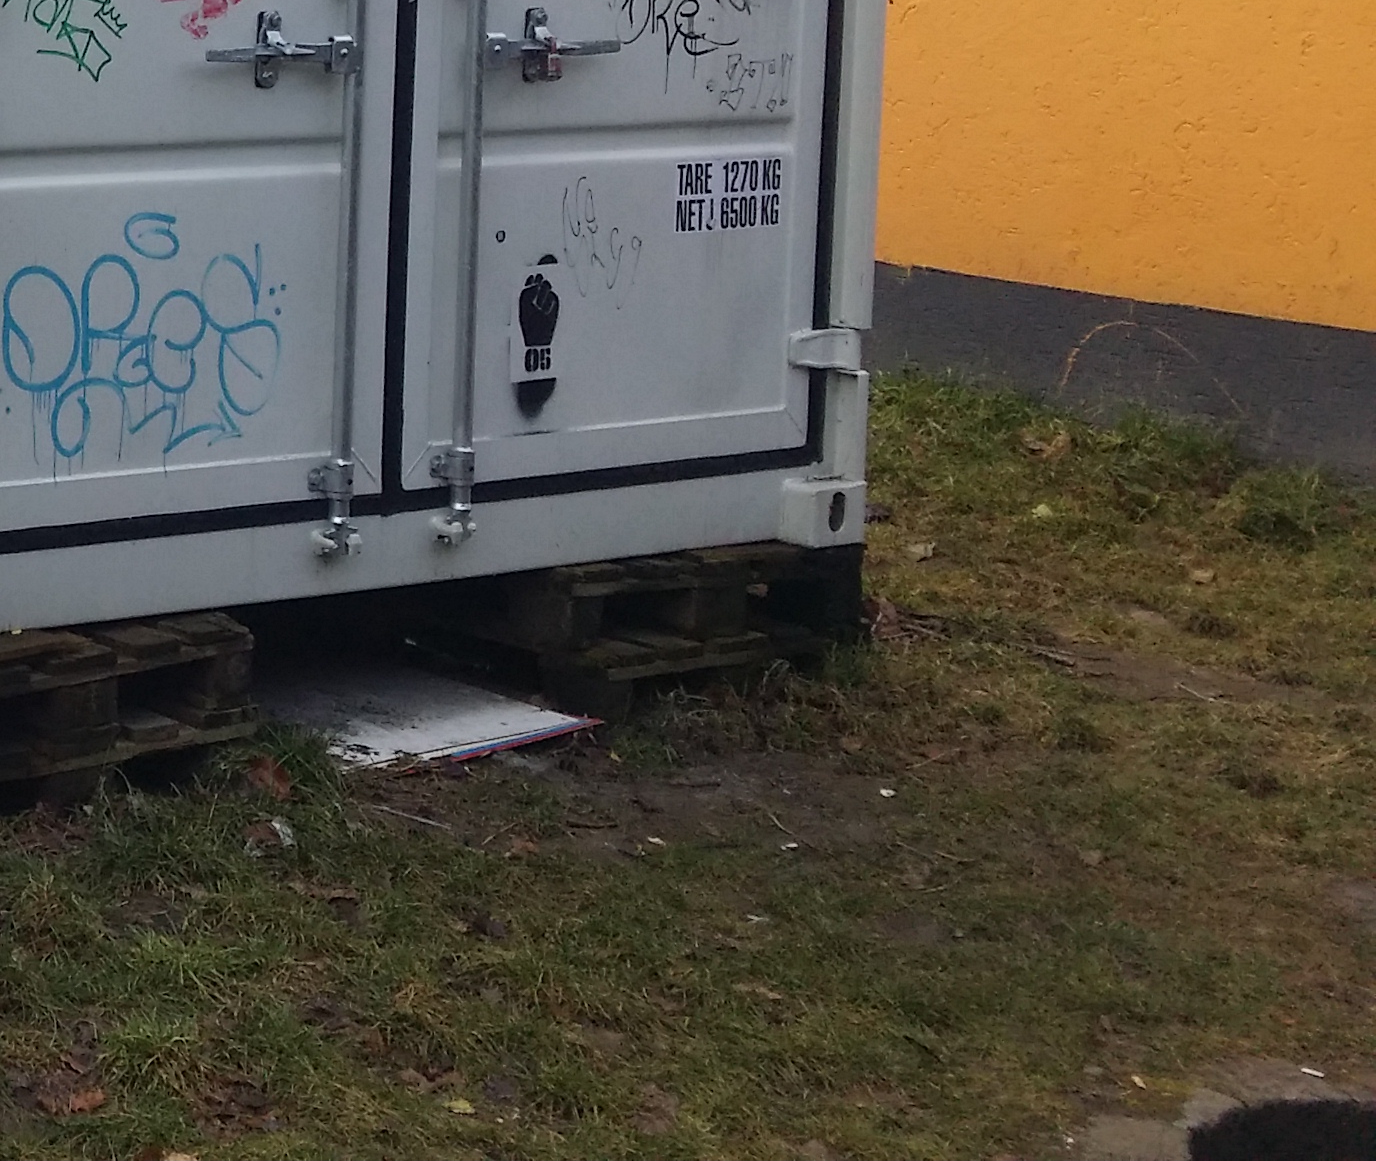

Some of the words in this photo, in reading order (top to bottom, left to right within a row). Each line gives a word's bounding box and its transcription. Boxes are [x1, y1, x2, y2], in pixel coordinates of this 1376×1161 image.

[676, 162, 713, 196] TARE
[722, 159, 759, 193] 1270
[761, 158, 782, 191] KG
[720, 195, 757, 229] 6500
[760, 193, 780, 226] KG
